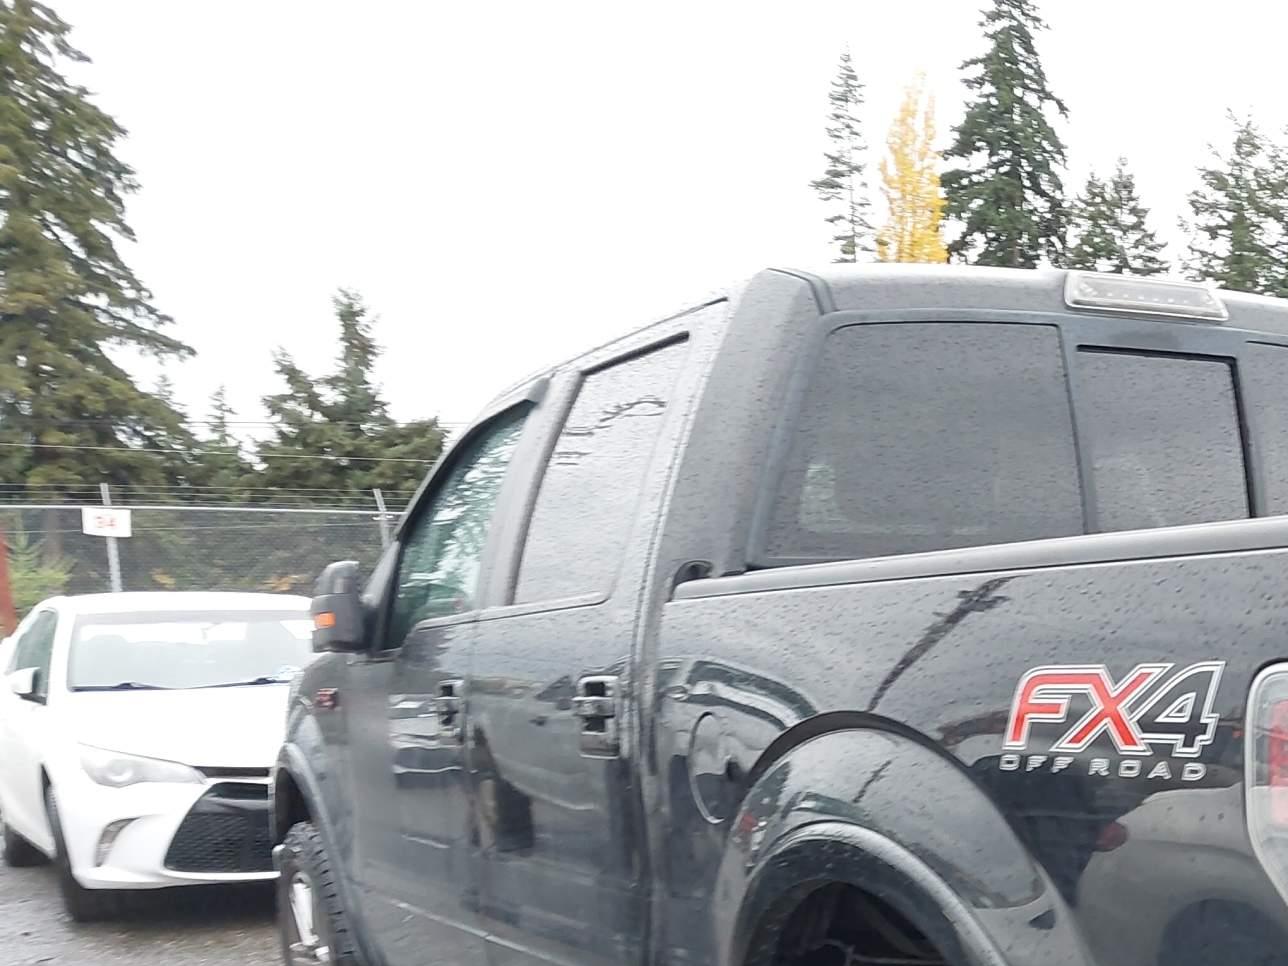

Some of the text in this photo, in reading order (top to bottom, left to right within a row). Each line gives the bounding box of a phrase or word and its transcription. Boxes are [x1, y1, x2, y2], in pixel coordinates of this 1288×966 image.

[1001, 660, 1226, 758] FX4
[999, 754, 1208, 782] OFF ROAD
